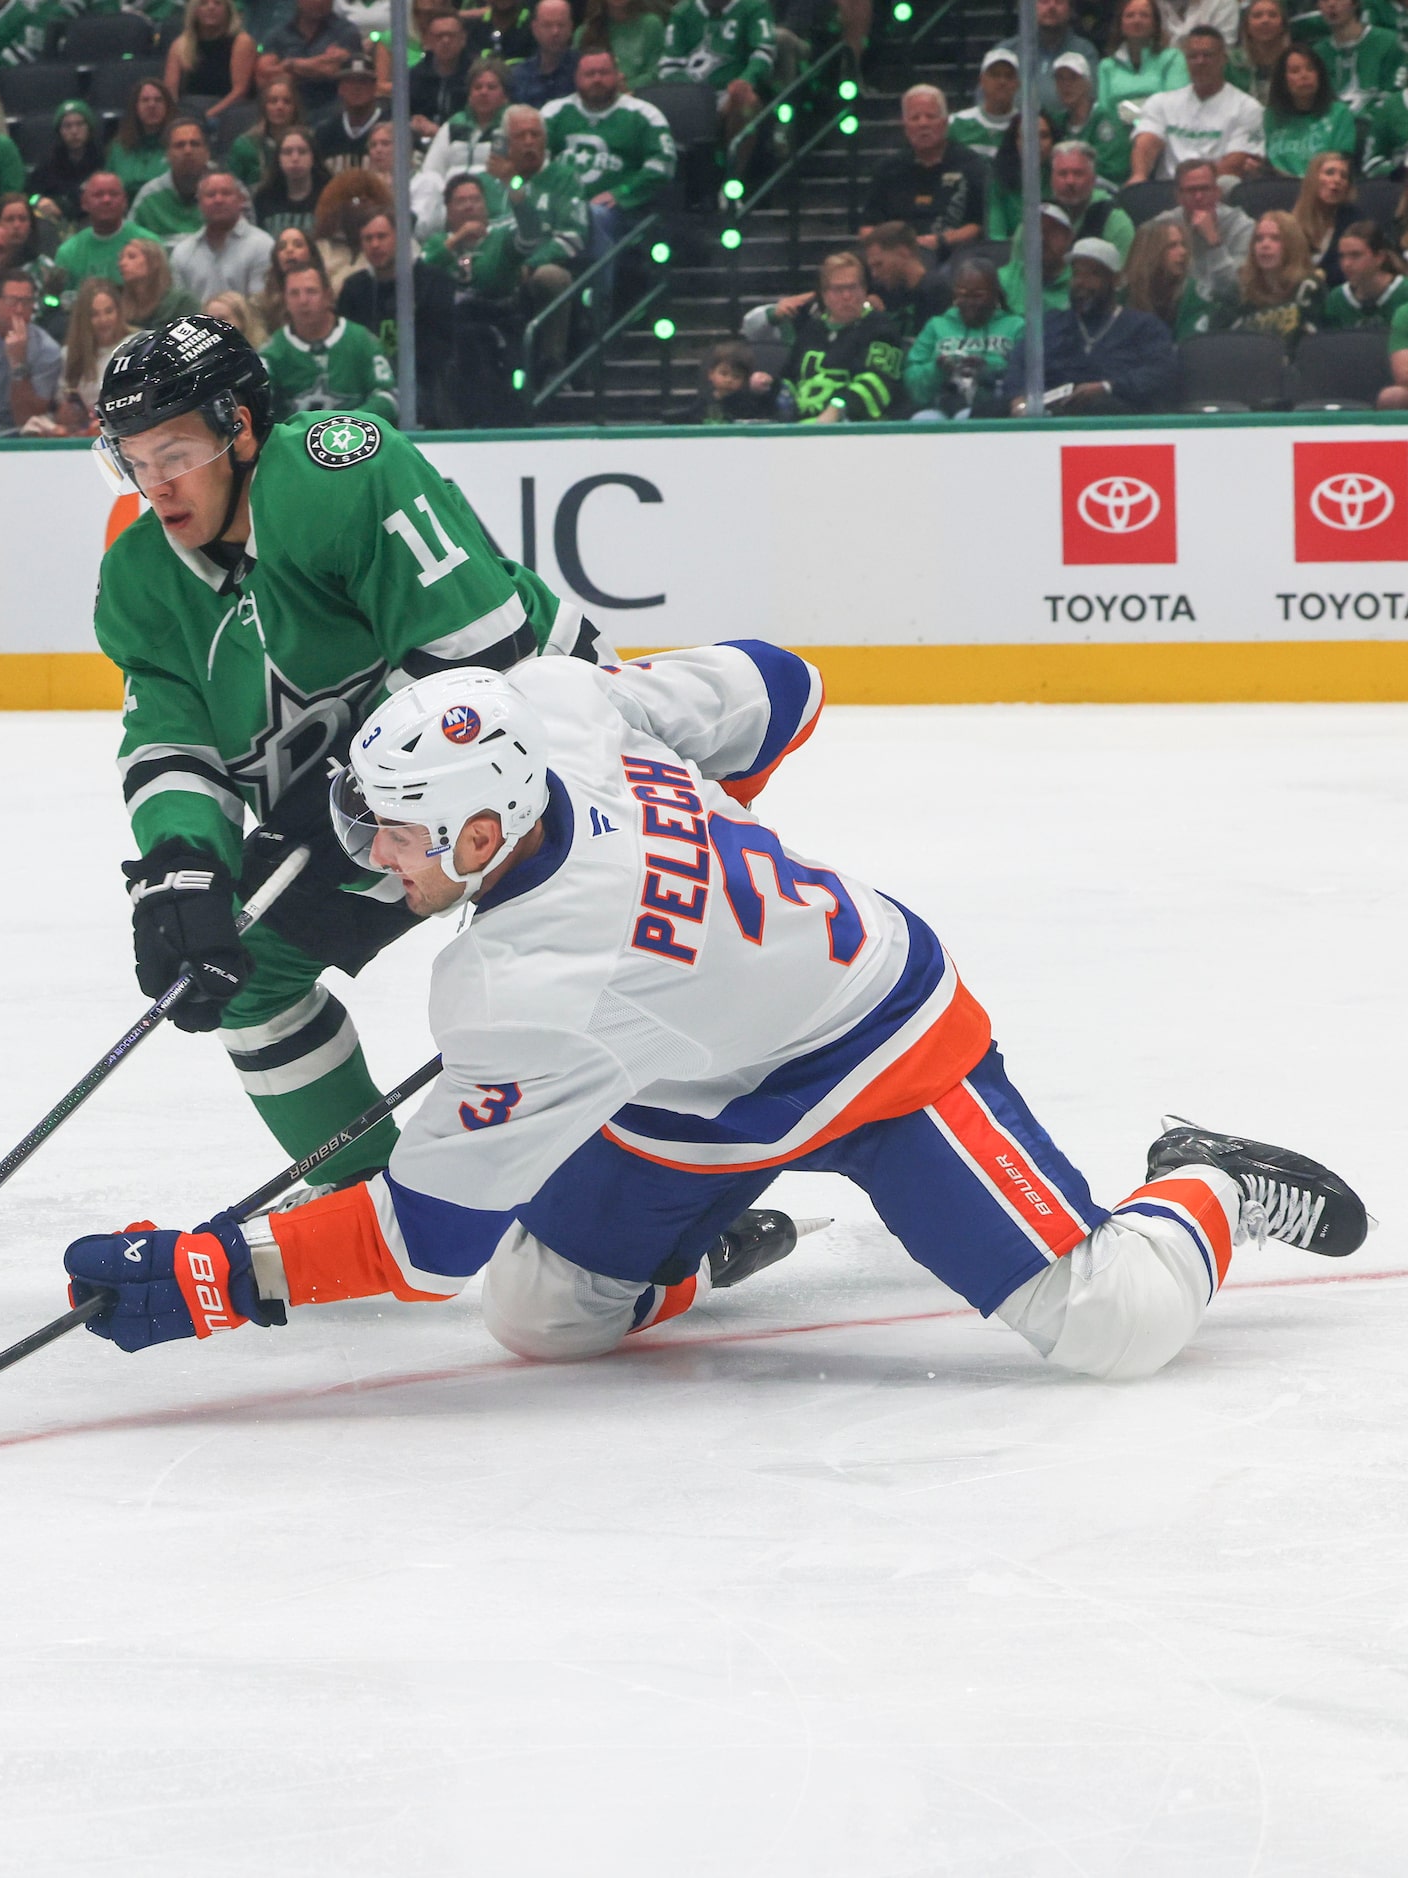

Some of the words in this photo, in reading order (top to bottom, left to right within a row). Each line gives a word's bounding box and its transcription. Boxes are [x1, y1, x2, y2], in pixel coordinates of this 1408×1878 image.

[177, 327, 211, 354] ENERGY
[180, 333, 223, 363] TRANSFER
[105, 392, 143, 412] CCM
[382, 493, 470, 588] 11
[1044, 594, 1197, 623] TOYOTA
[1275, 592, 1408, 621] TOYOT
[362, 726, 382, 750] 3
[621, 754, 710, 966] PELECH
[130, 870, 215, 904] UE
[707, 810, 867, 966] 3
[202, 963, 240, 984] TRUE
[458, 1081, 523, 1132] 3
[288, 1138, 340, 1181] BAUER
[995, 1153, 1054, 1216] BAUER
[187, 1251, 232, 1335] BAU
